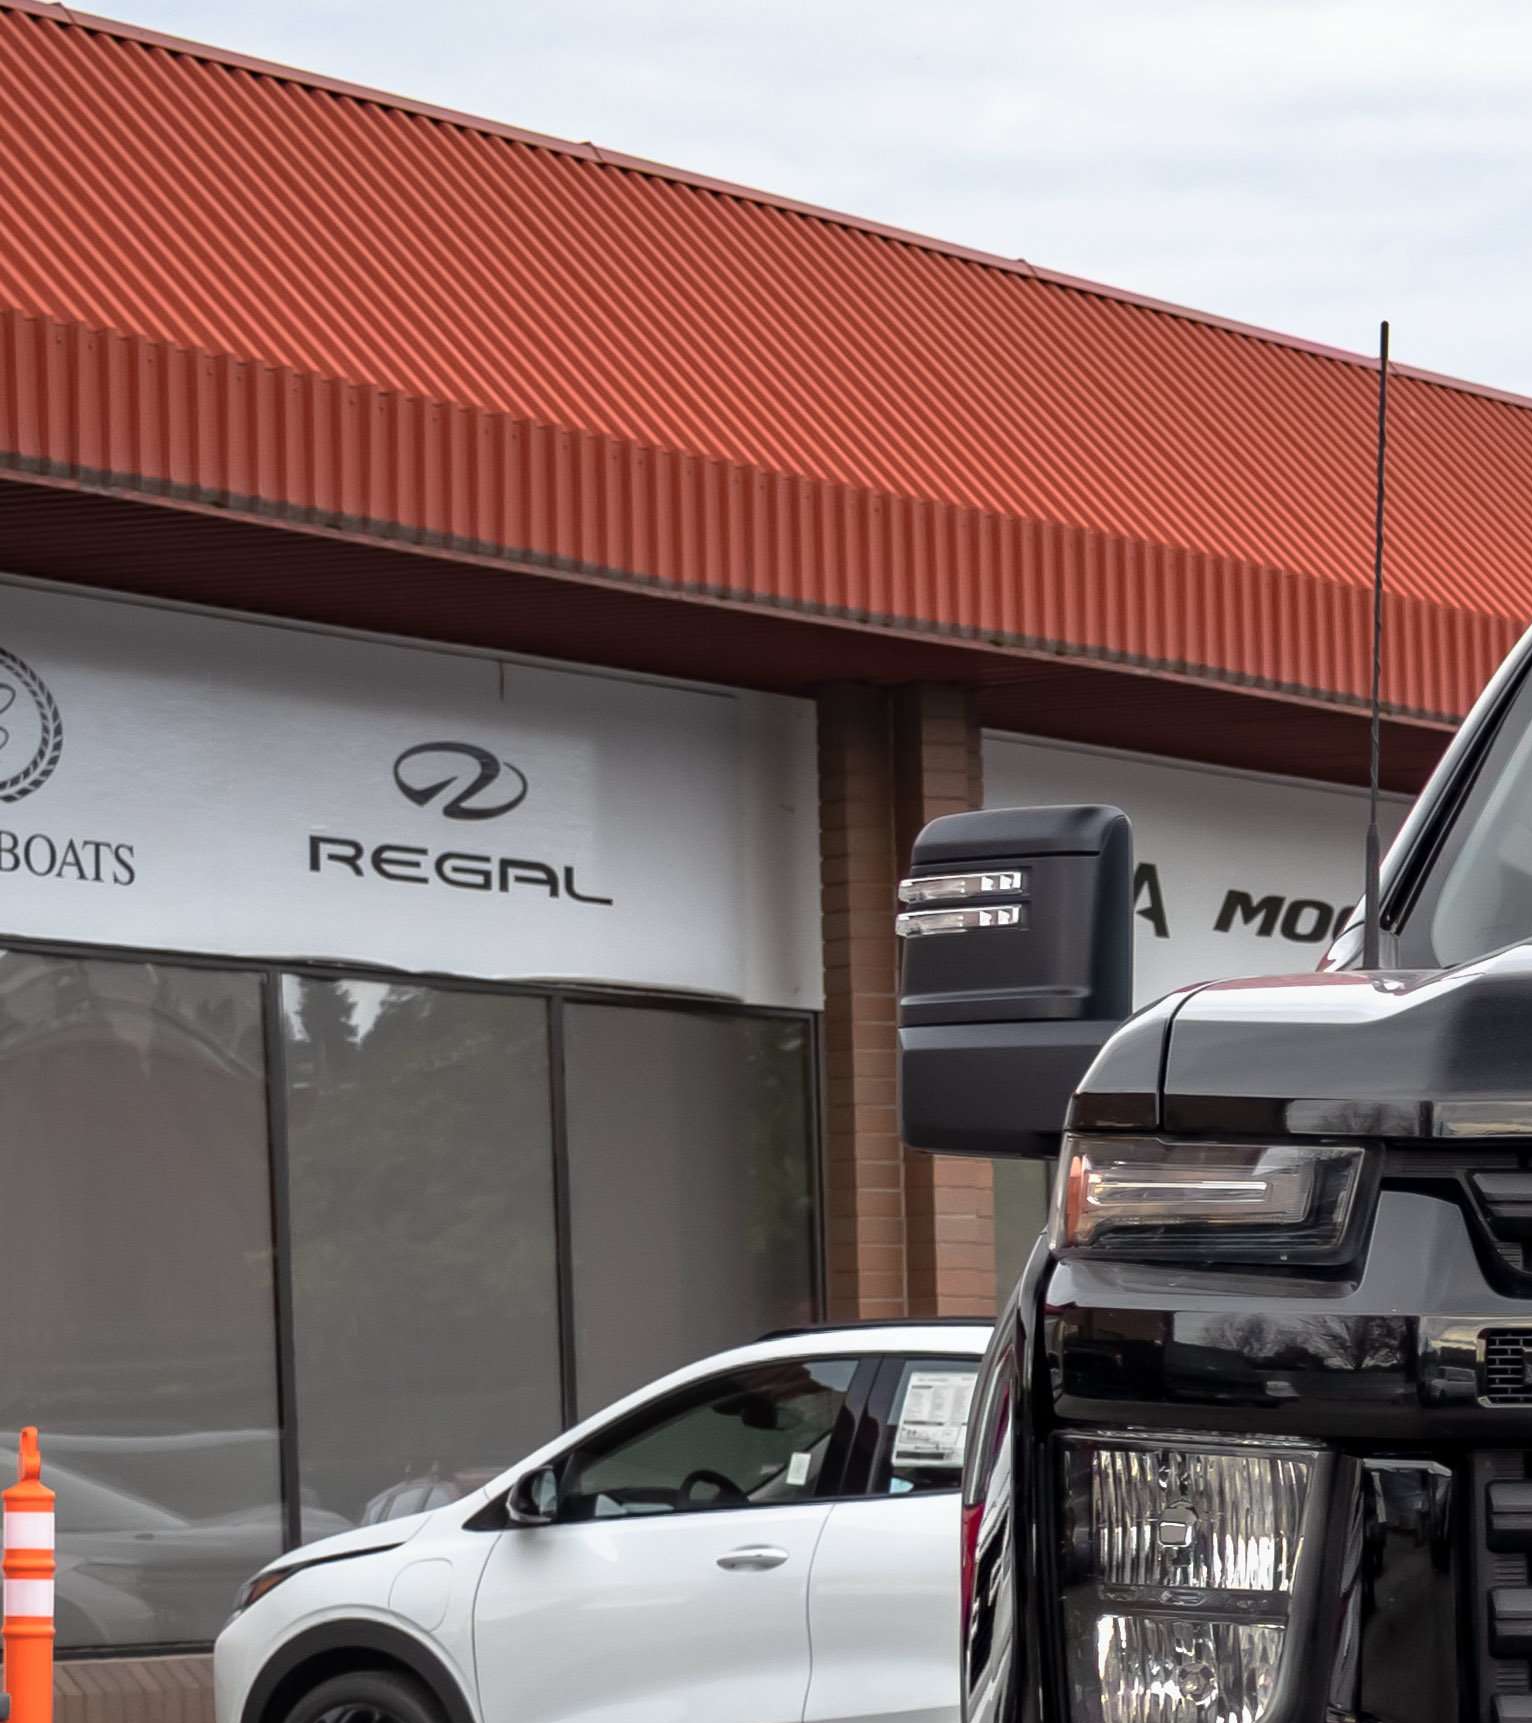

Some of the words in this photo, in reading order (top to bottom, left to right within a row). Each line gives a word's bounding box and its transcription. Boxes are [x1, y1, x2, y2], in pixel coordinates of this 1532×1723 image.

[0, 830, 136, 886] BOATS
[309, 835, 614, 906] REGAL
[1213, 889, 1357, 943] MO
